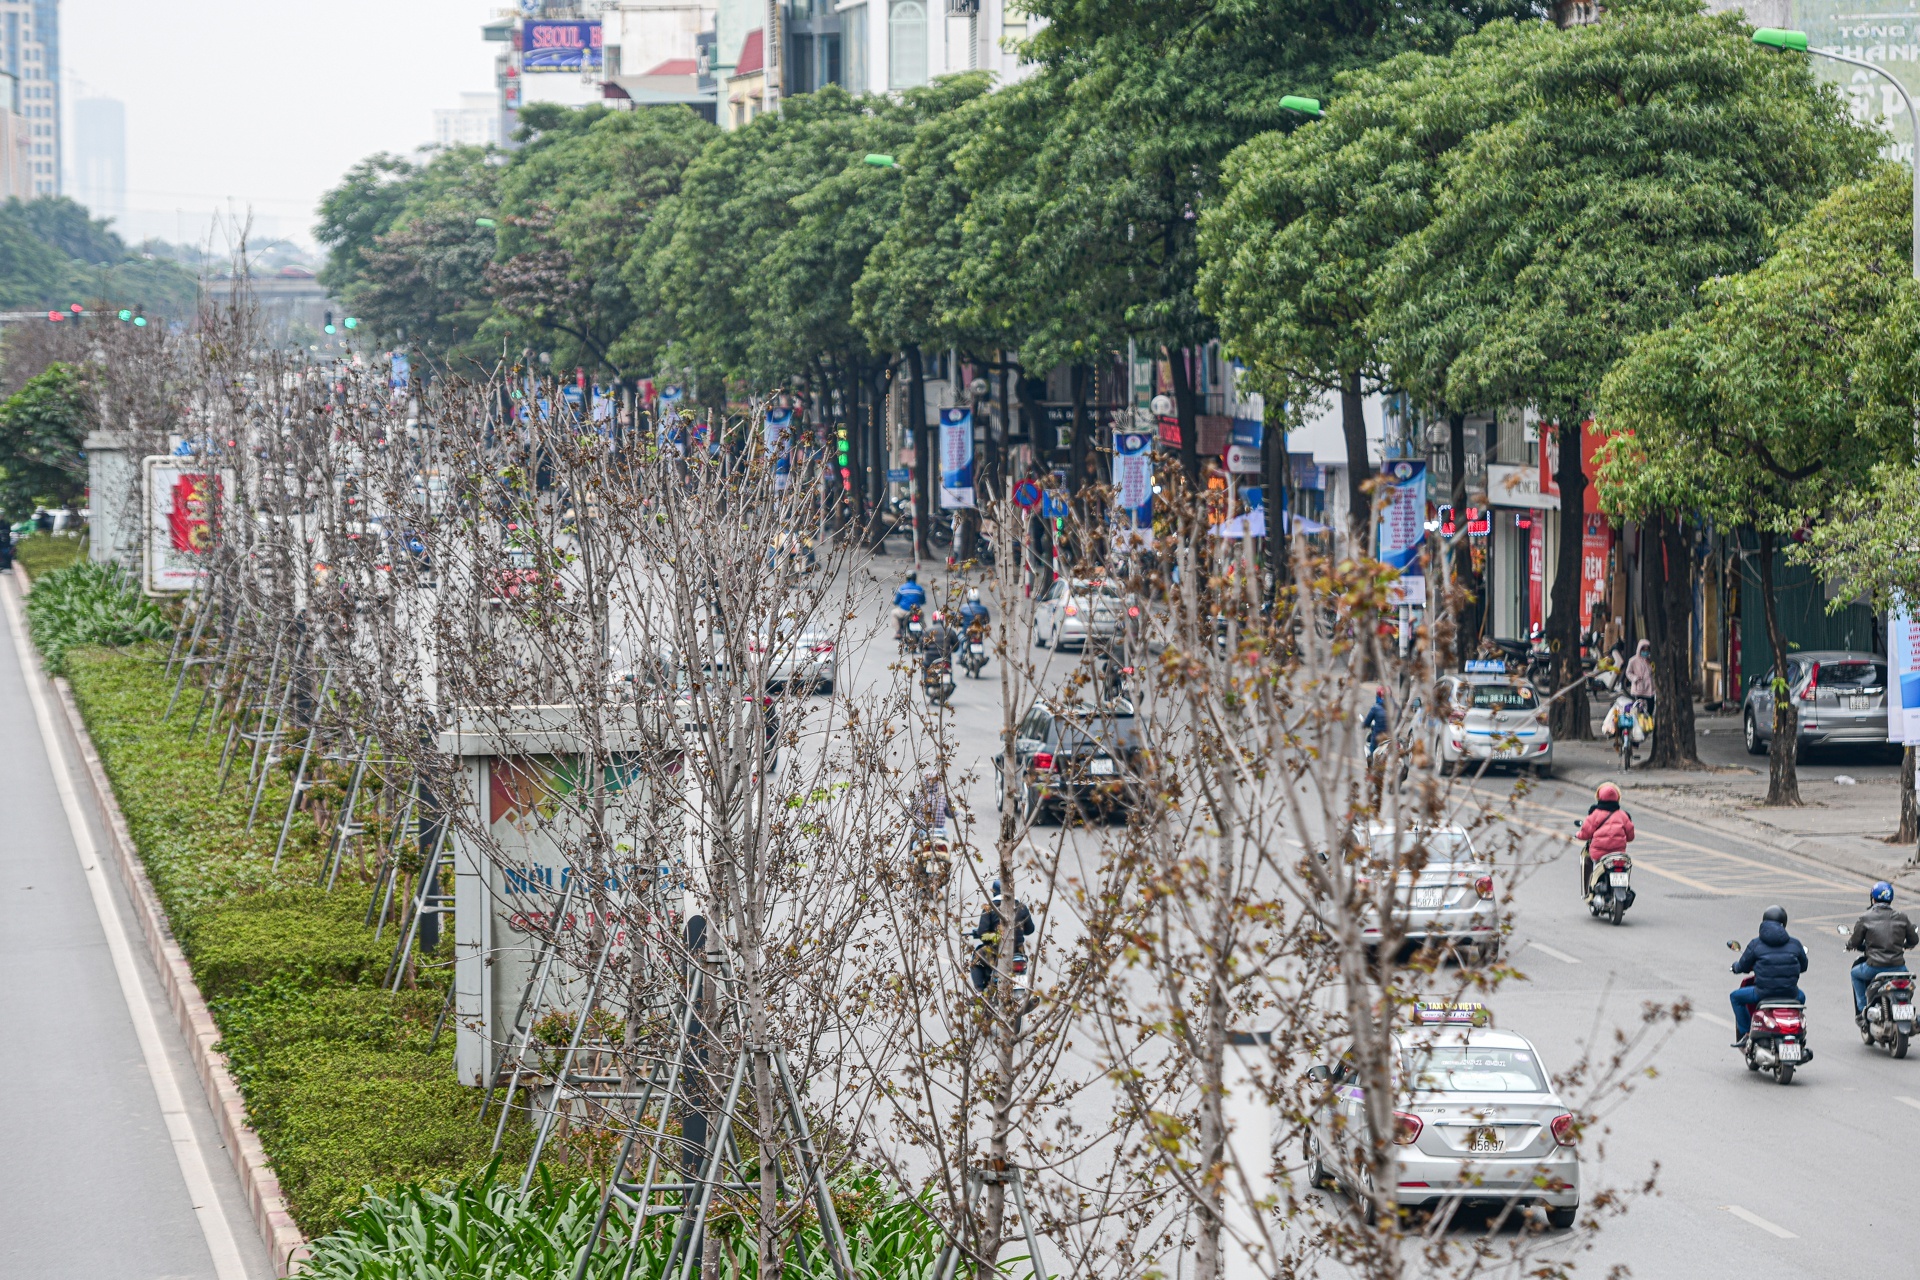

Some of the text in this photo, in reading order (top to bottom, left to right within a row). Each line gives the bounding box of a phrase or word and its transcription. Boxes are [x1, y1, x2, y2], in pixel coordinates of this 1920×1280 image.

[532, 25, 584, 48] SEOUL
[1584, 552, 1602, 580] RÈM
[1428, 1002, 1444, 1010] TAXI
[1470, 1141, 1504, 1152] 058.97
